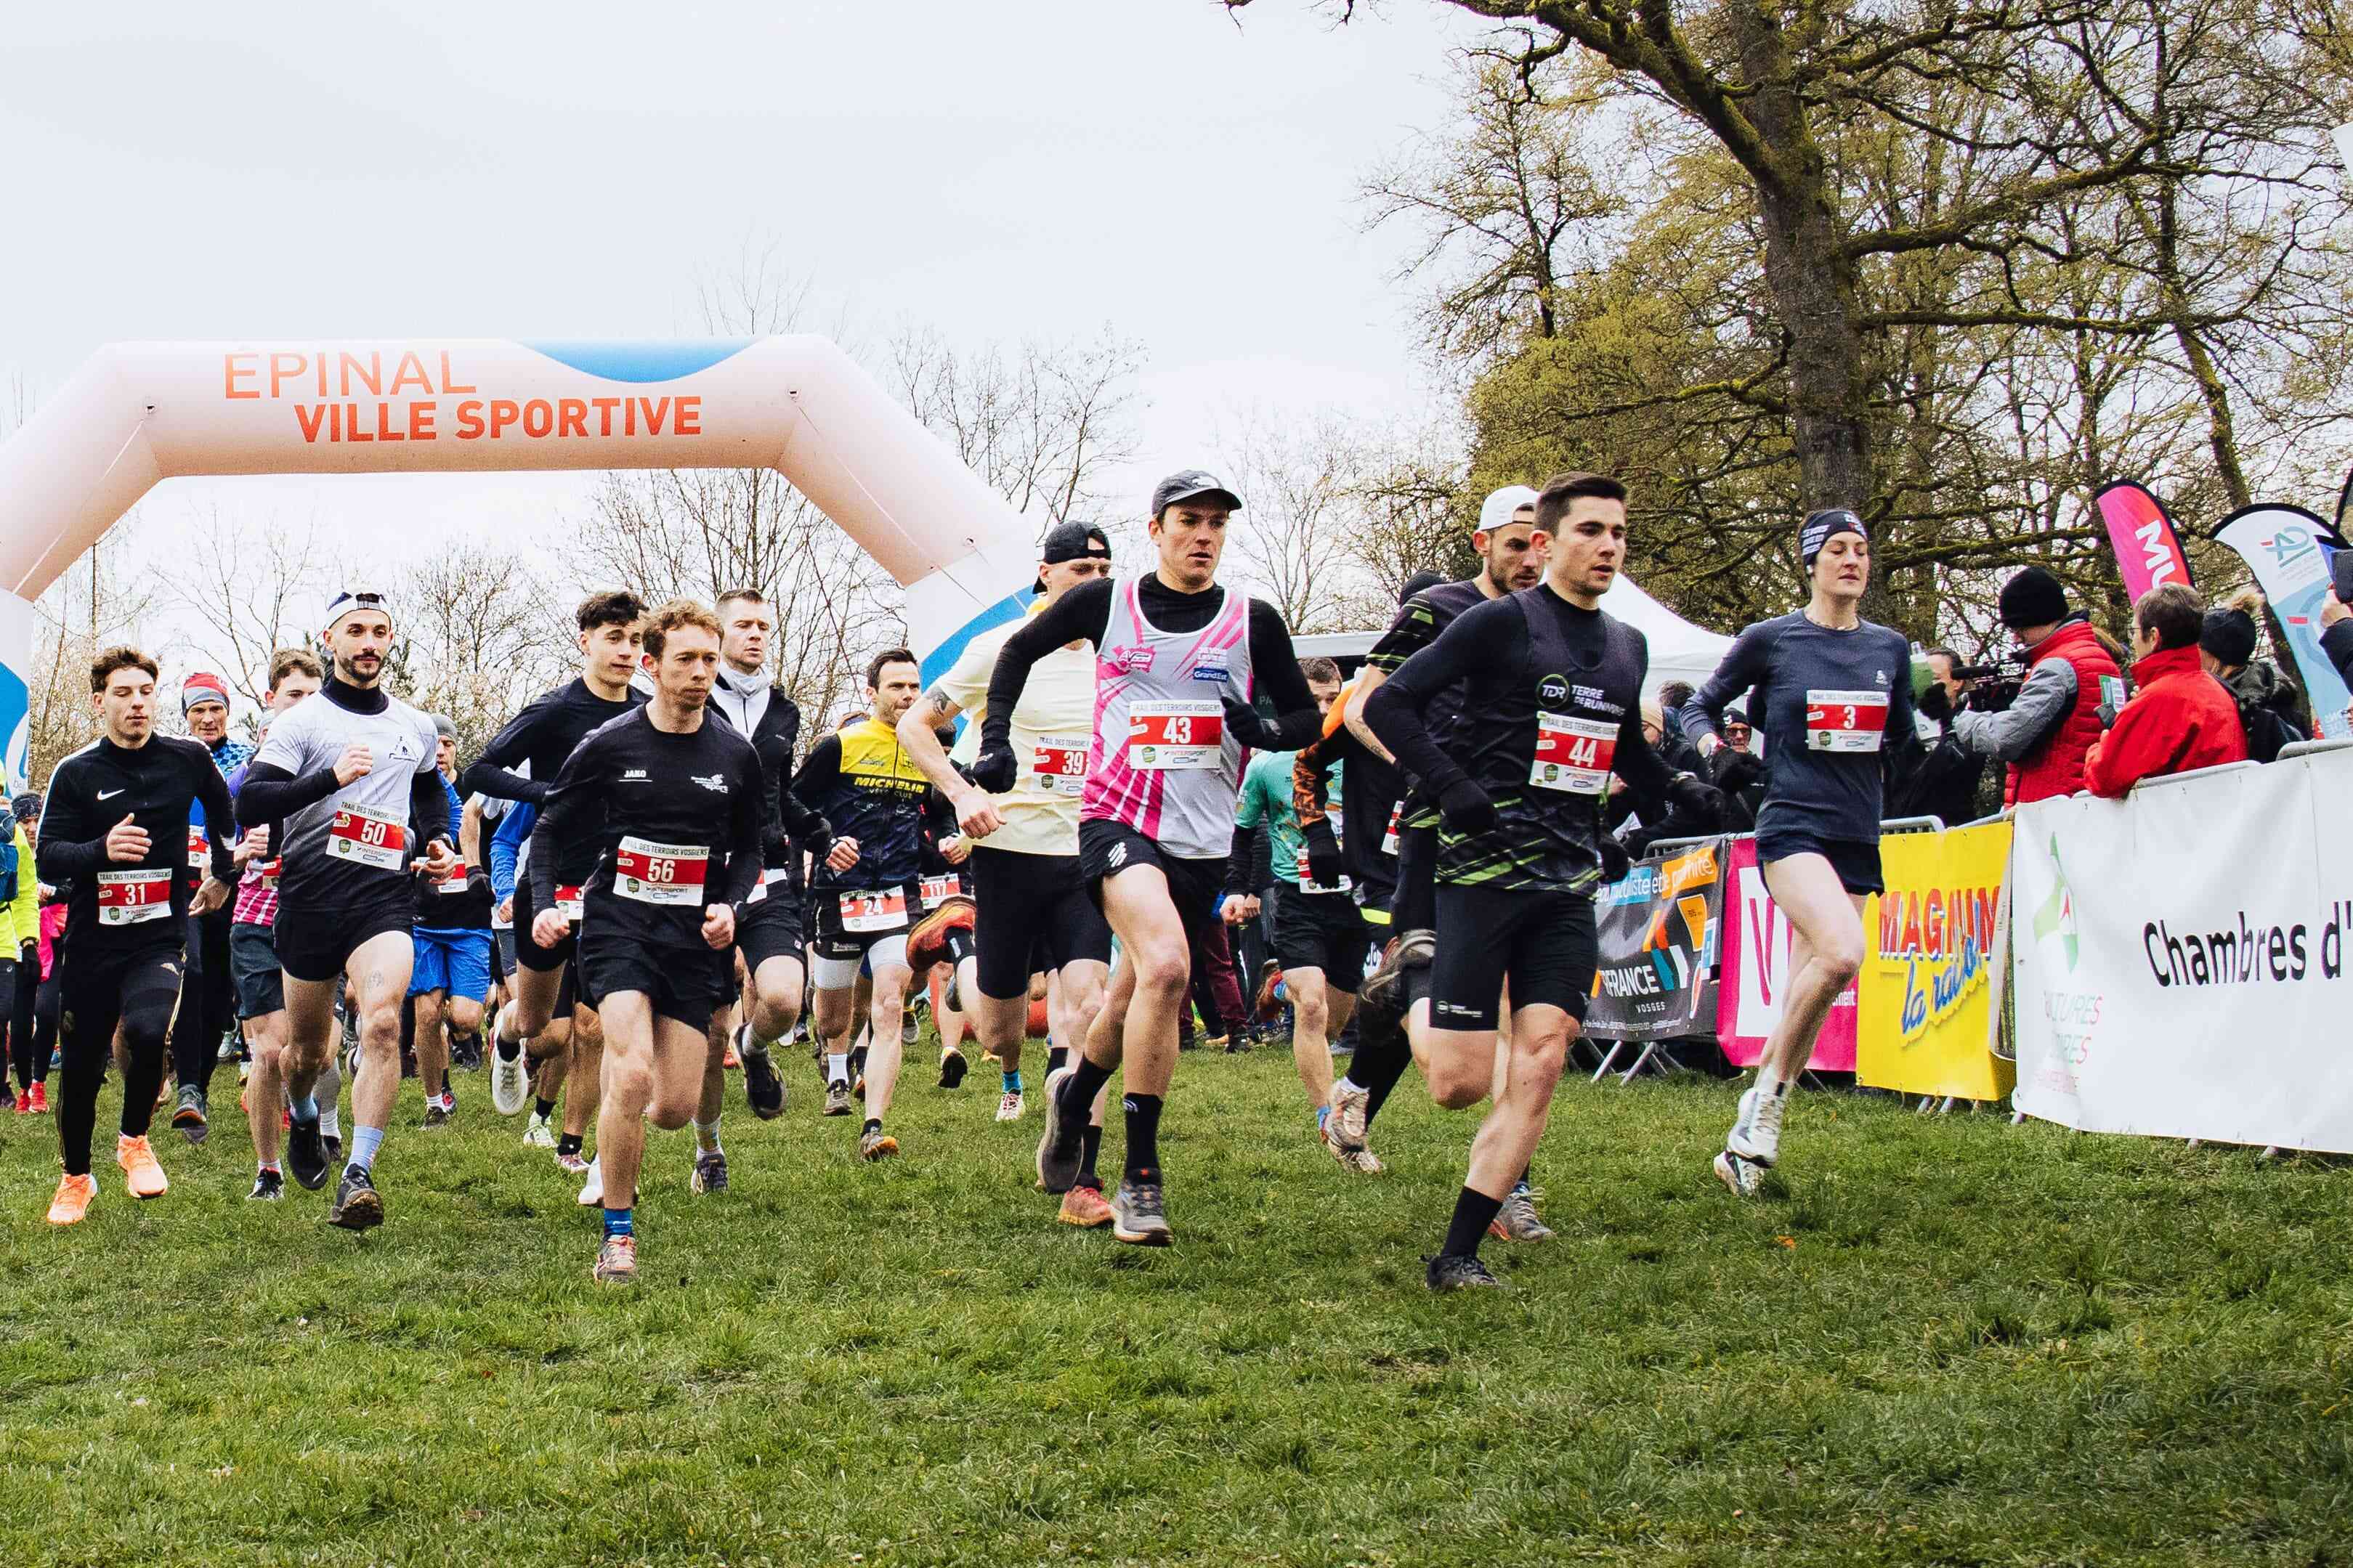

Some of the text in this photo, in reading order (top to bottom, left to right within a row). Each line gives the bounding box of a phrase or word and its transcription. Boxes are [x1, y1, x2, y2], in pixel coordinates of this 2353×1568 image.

[294, 396, 702, 442] VILLE SPORTIVE
[1542, 684, 1604, 699] TDR TERRE
[1584, 699, 1626, 716] RUNNING
[1844, 706, 1855, 729] 3
[1162, 717, 1191, 744] 43
[1062, 751, 1084, 775] 39
[1568, 737, 1597, 768] 44
[854, 776, 925, 793] MICHELIN
[341, 802, 355, 811] TRAIL
[356, 805, 366, 814] DES
[361, 820, 386, 845] 50
[651, 845, 679, 856] TERROIRS
[647, 858, 676, 883] 56
[124, 883, 145, 905] 31
[863, 898, 883, 915] 24
[1879, 886, 2000, 962] MAGNUM
[2144, 900, 2352, 987] Chambres d'
[1635, 1002, 1666, 1013] VOSGES
[1901, 959, 1926, 1034] la
